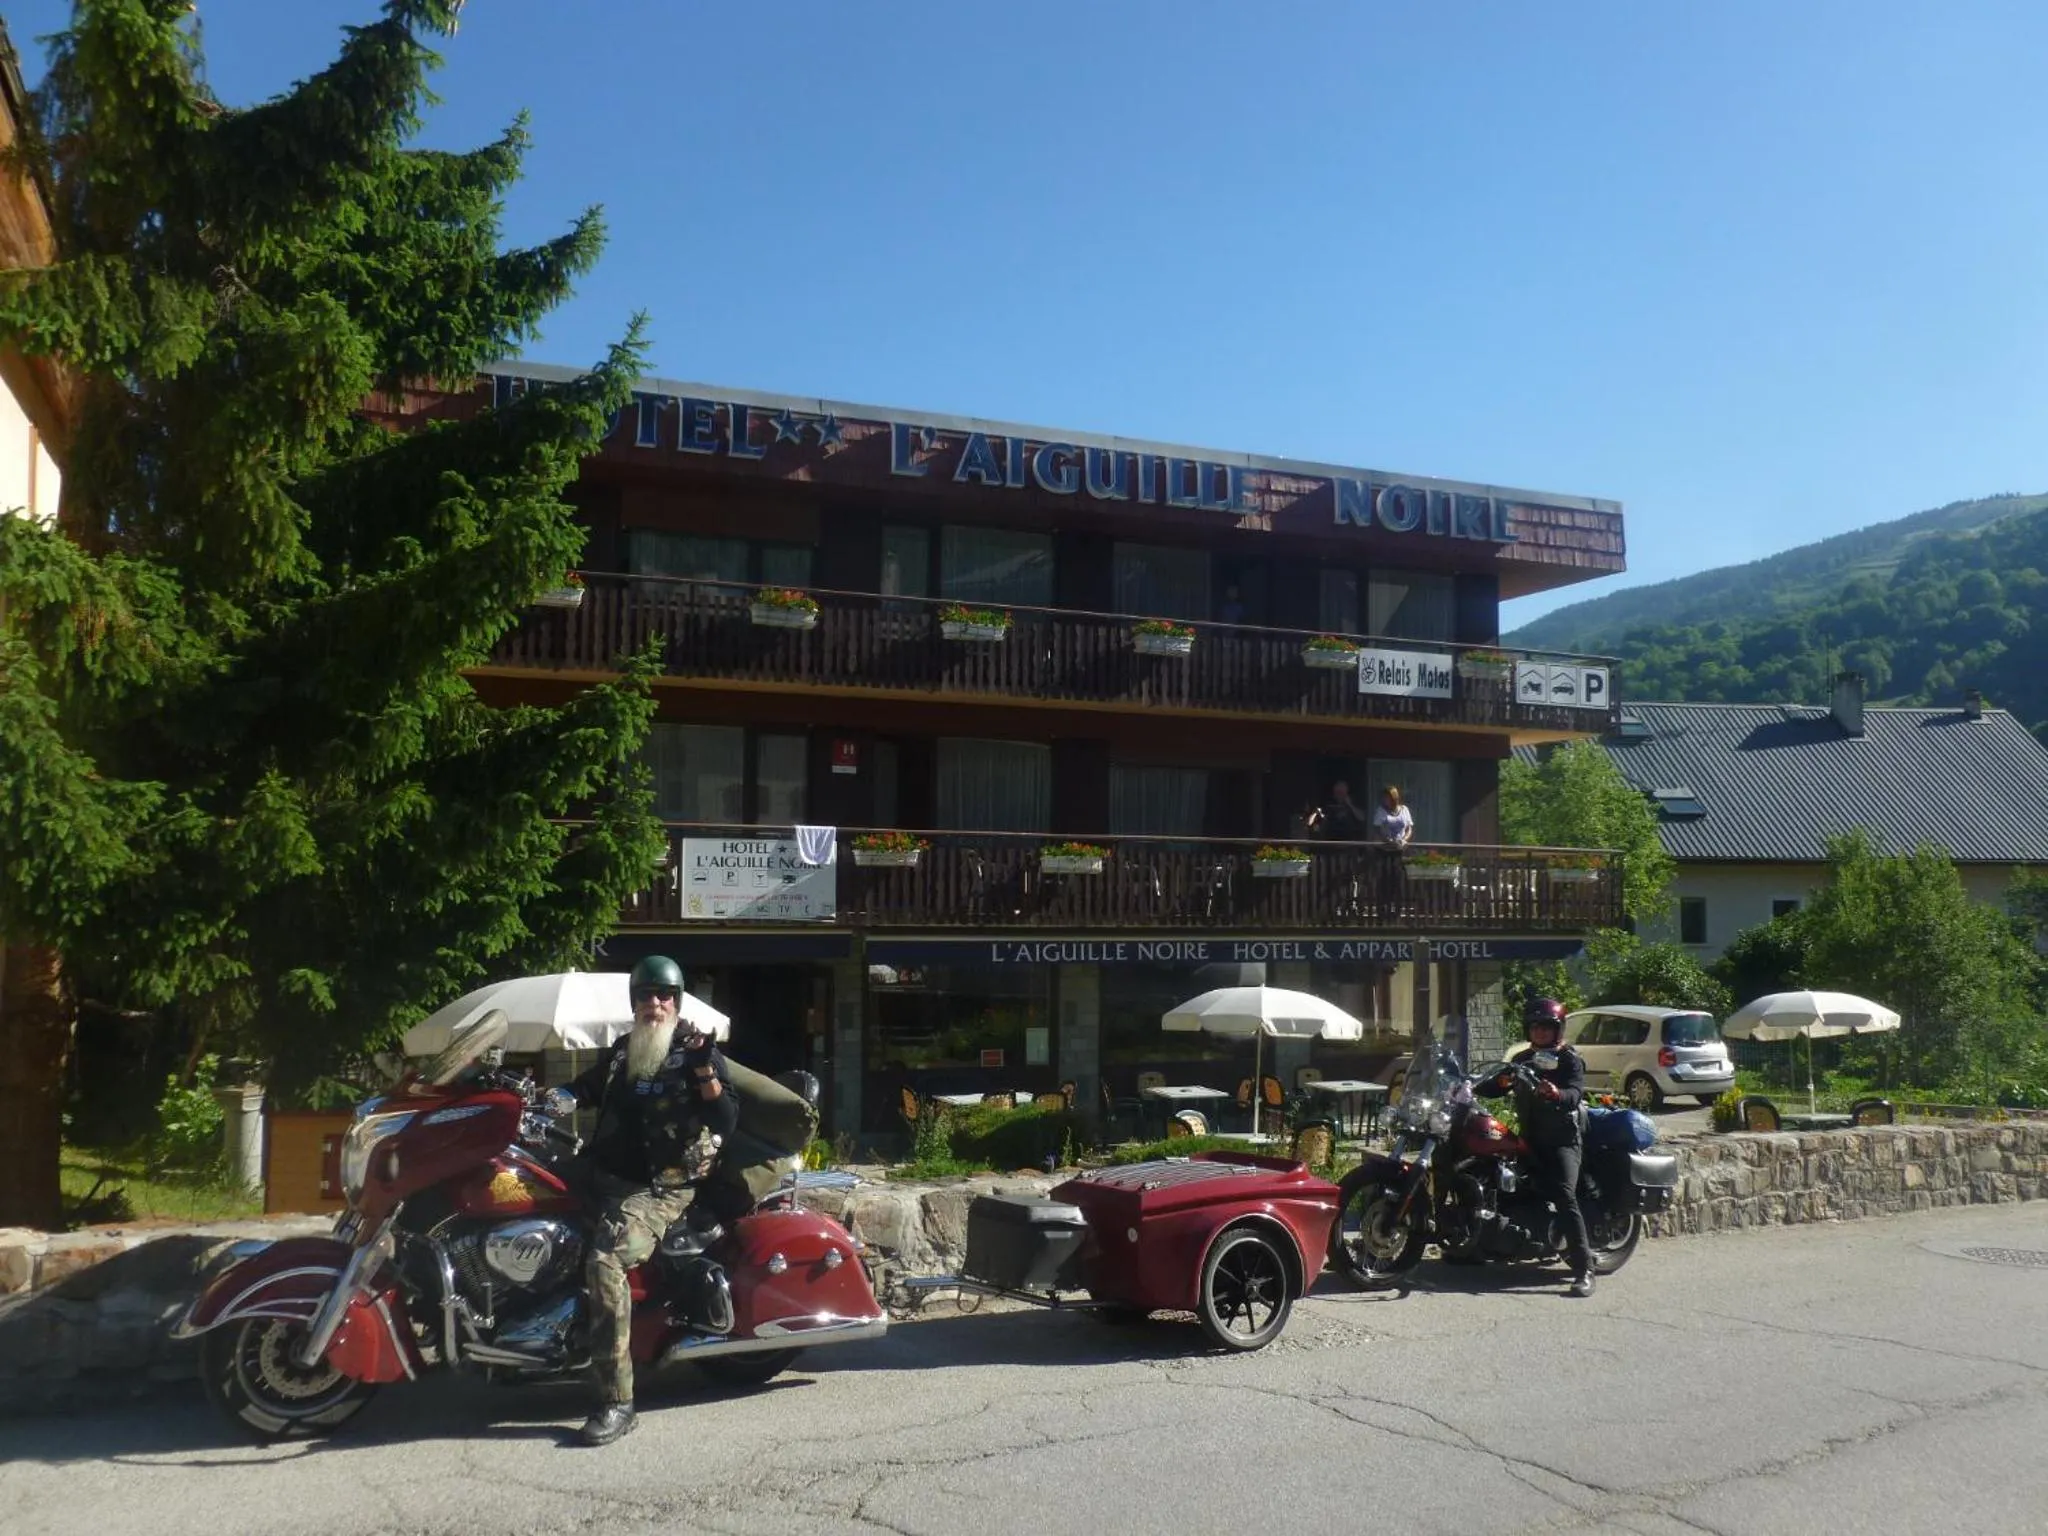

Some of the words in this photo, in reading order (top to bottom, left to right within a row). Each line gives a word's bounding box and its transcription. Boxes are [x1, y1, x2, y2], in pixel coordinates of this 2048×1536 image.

[492, 375, 768, 461] TEL
[889, 421, 1263, 515] L'AIGUILLE
[1333, 476, 1521, 543] NOIRE
[1378, 659, 1411, 687] Relais
[1417, 662, 1450, 689] Motos
[1585, 673, 1604, 702] P
[723, 842, 772, 854] HOTEL
[696, 855, 775, 869] L'AIGUILLE
[991, 942, 1129, 963] L'AIGUILLE
[1138, 941, 1210, 961] NOIRE
[1233, 942, 1306, 961] HOTEL
[1314, 941, 1331, 960] &
